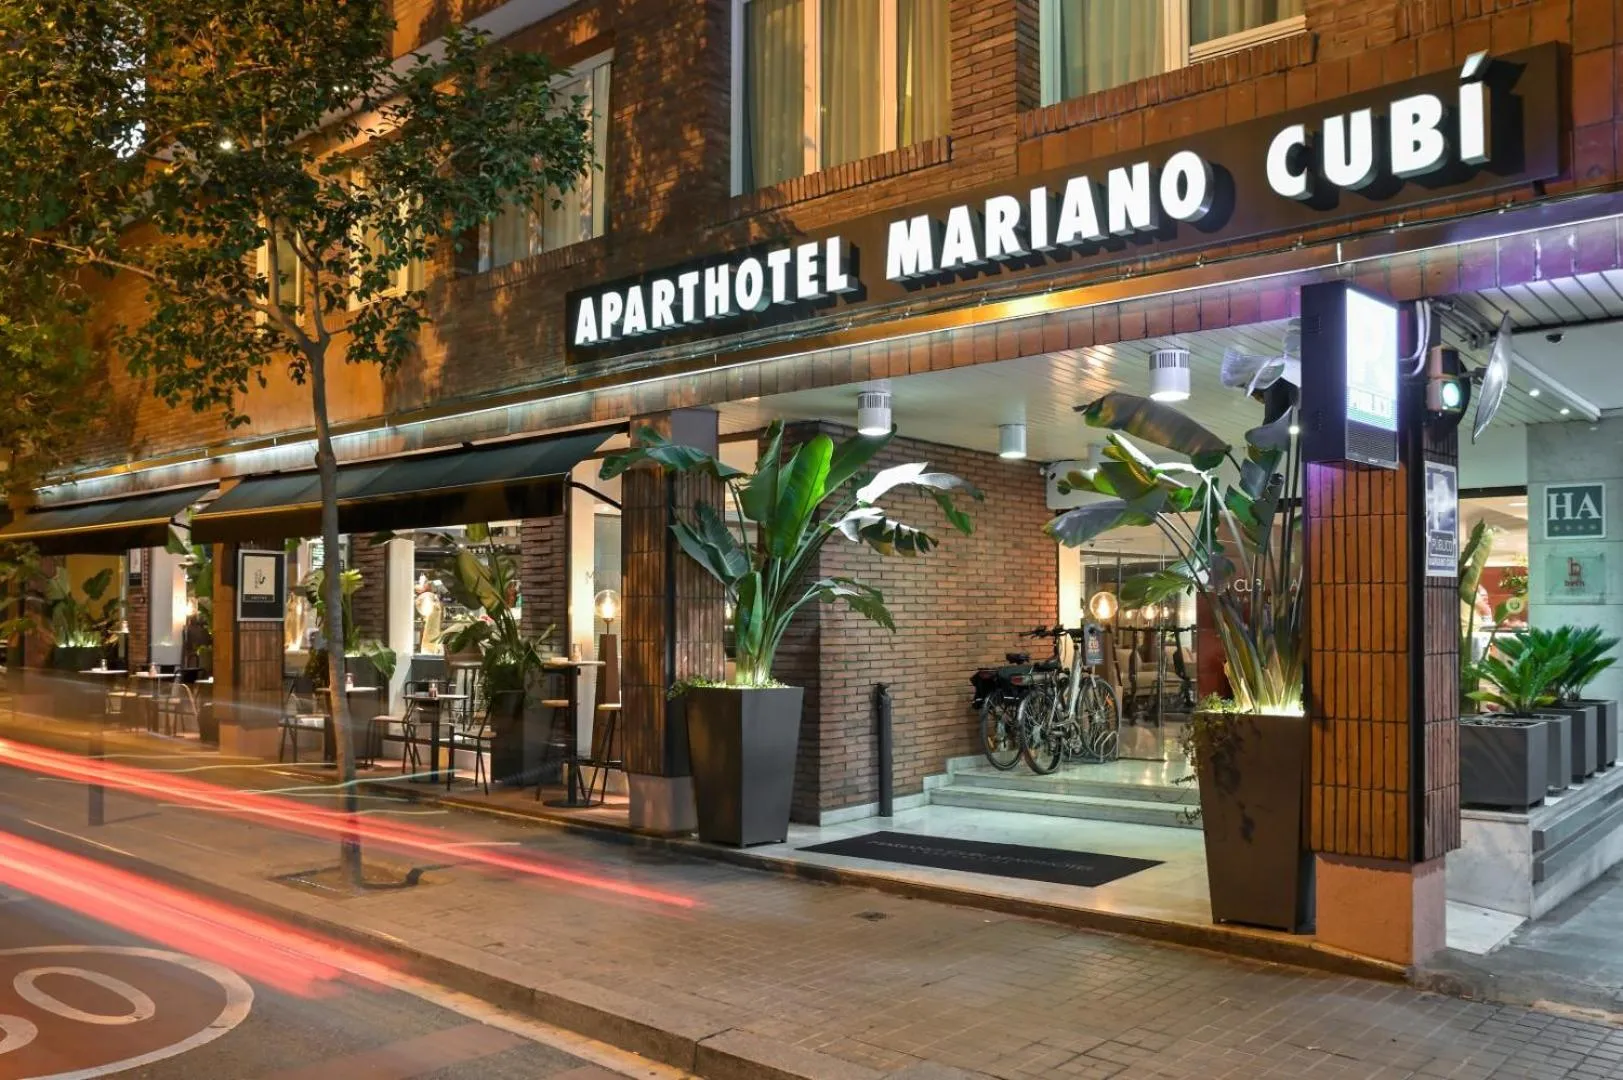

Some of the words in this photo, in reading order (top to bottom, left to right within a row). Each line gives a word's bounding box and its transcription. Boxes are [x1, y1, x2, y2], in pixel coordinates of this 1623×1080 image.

[573, 236, 852, 346] APARTHOTEL
[885, 150, 1210, 281] MARIANO
[1266, 51, 1490, 199] CUBÍ
[1548, 491, 1602, 520] HA
[0, 966, 156, 1054] 0
